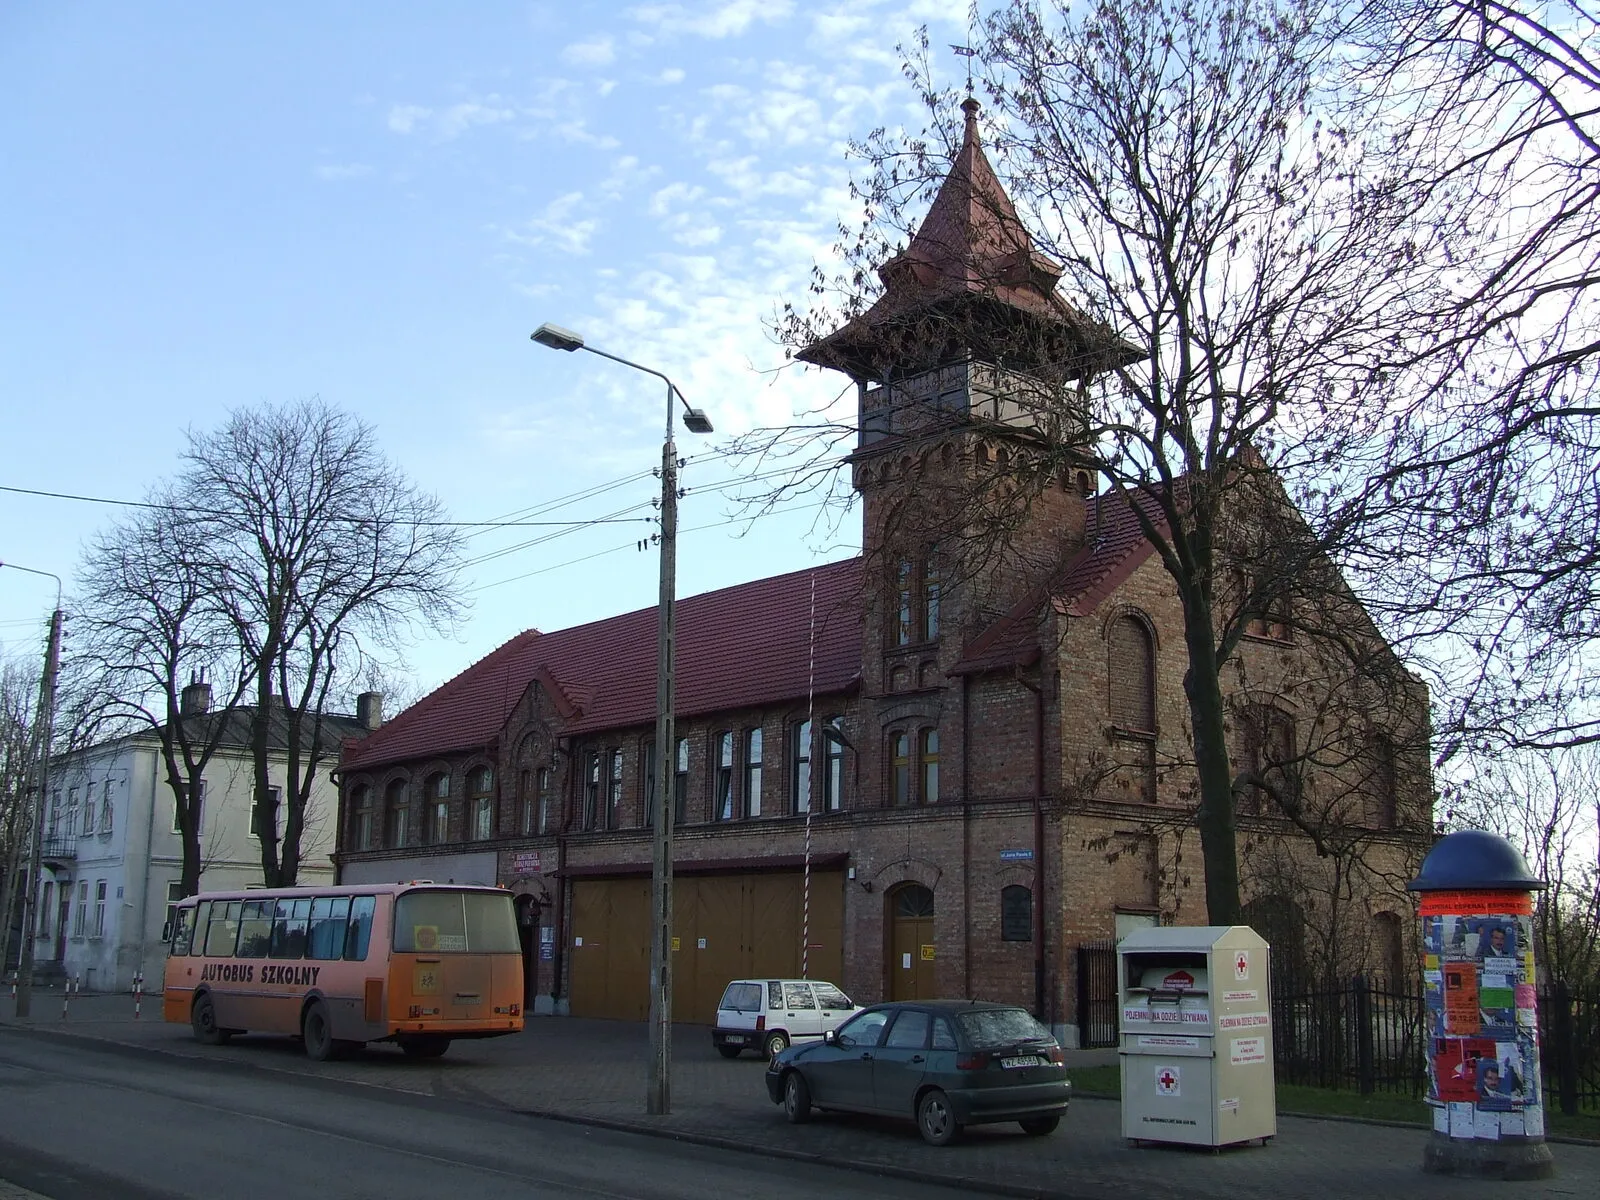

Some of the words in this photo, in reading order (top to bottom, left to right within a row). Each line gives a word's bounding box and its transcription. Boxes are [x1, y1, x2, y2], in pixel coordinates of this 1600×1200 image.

[200, 963, 255, 983] AUTOBUS
[260, 965, 321, 986] SZKOLNY
[1152, 1011, 1160, 1021] NA
